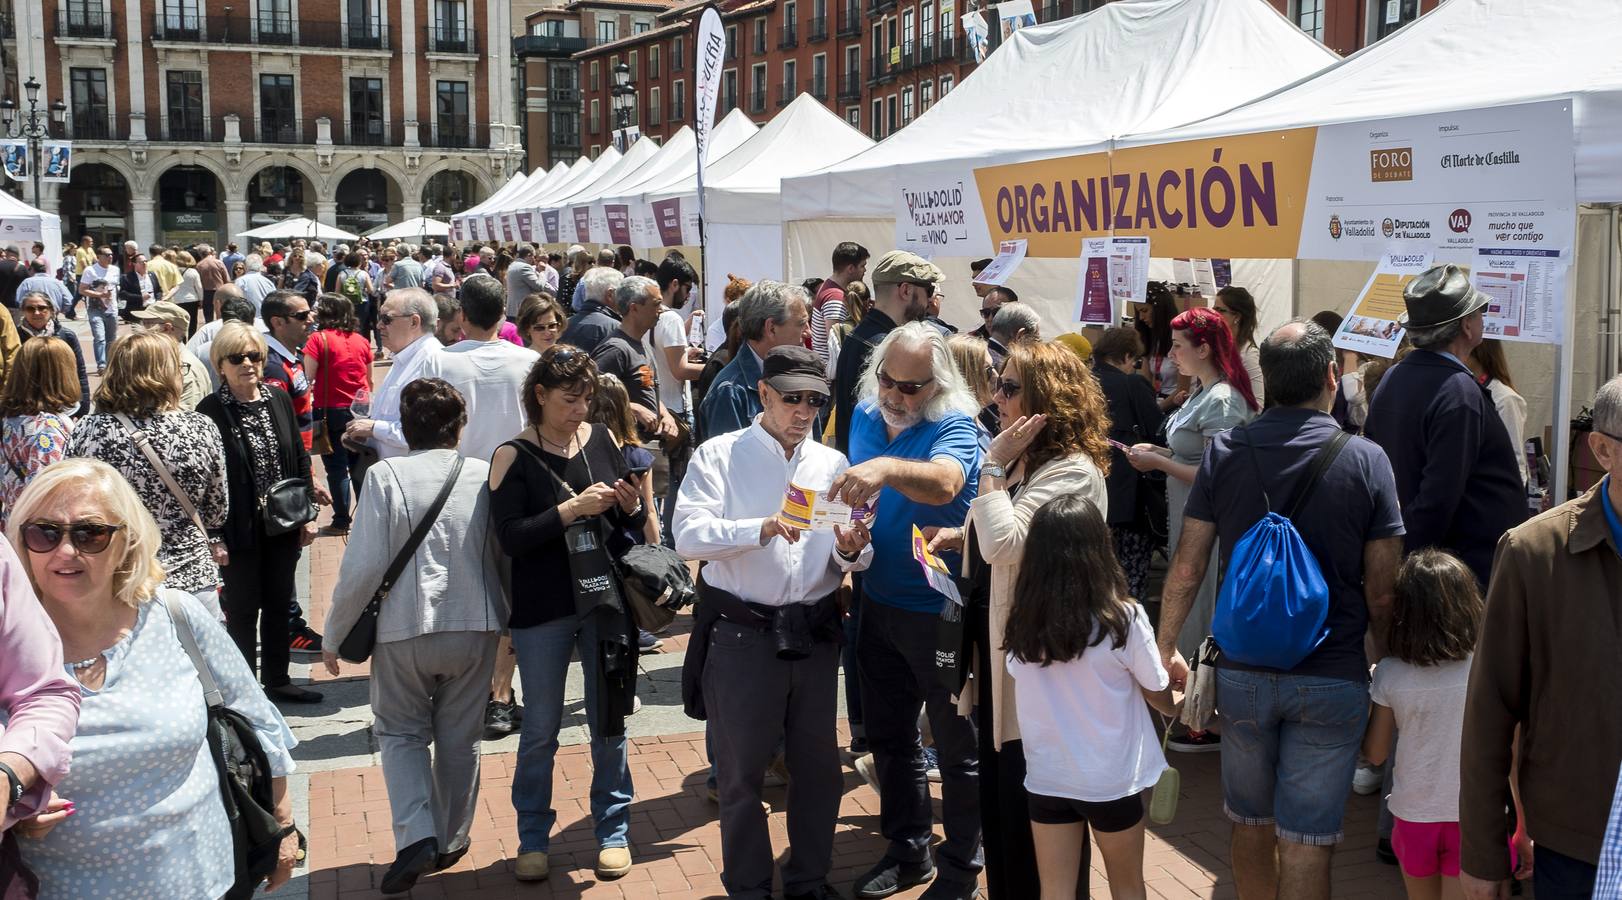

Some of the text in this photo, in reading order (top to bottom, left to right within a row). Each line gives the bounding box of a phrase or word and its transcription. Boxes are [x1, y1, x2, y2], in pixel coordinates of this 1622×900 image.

[1372, 151, 1410, 169] FORO
[1453, 153, 1474, 167] Norte
[1475, 154, 1484, 166] de
[1485, 150, 1520, 166] Castilla
[1385, 170, 1411, 178] DEBATE
[996, 148, 1278, 234] ORGANIZACIÓN
[915, 210, 965, 226] PLAZA MAYOR
[1395, 219, 1430, 229] DIPUTACIÓN
[1450, 215, 1468, 228] VA!
[1344, 227, 1375, 237] Valladolid
[1488, 221, 1534, 231] mucho que
[928, 229, 948, 245] VINO
[1402, 231, 1431, 239] VALLADOLID
[1512, 231, 1544, 243] contigo
